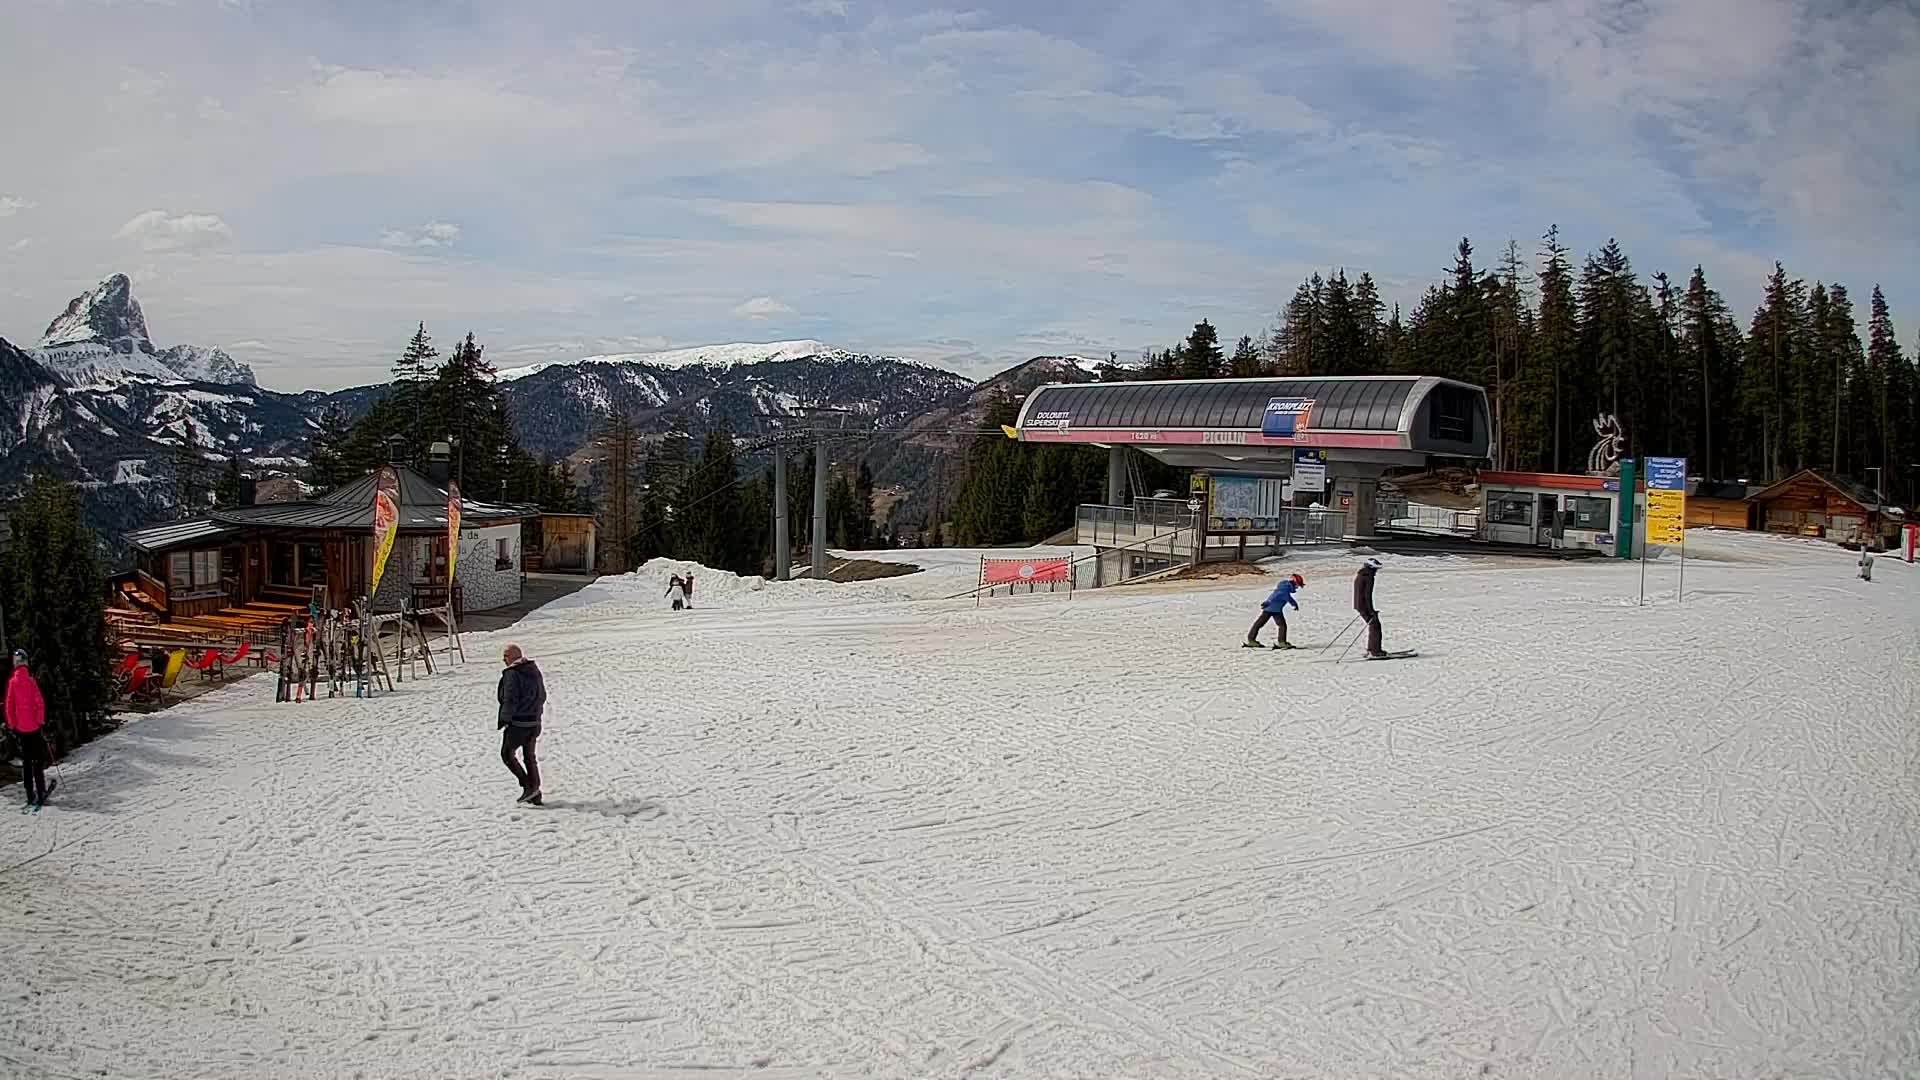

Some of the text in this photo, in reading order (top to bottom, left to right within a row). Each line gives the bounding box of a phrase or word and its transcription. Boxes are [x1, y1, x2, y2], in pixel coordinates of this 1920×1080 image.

[1036, 411, 1070, 419] DOLOMITI
[1026, 419, 1059, 427] SUPERSKI
[1202, 431, 1247, 444] PICULIN
